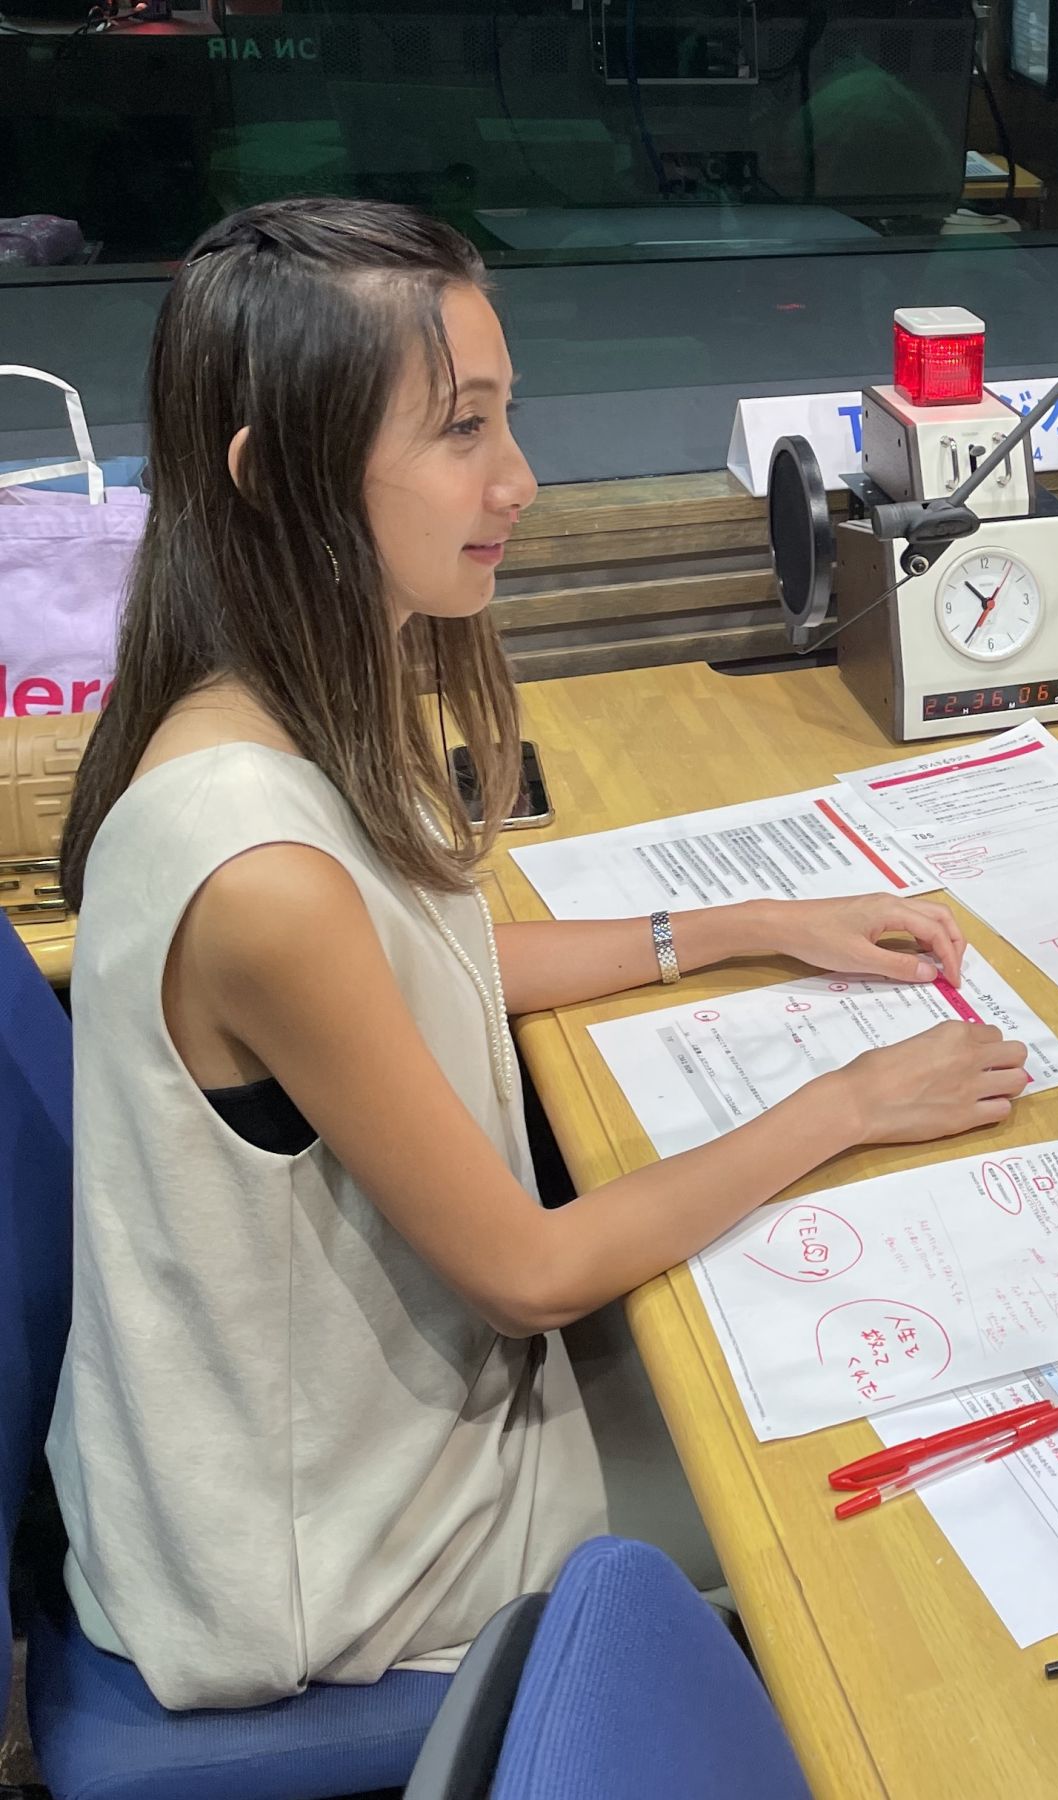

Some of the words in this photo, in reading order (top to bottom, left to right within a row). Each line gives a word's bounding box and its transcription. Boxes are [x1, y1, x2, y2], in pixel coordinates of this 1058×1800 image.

[980, 557, 989, 569] 12
[1023, 593, 1030, 605] 3
[945, 602, 952, 614] 9
[987, 638, 994, 650] 6
[925, 696, 957, 716] 22
[972, 691, 1003, 709] 36
[1018, 684, 1049, 704] 06
[883, 1311, 922, 1361] 人生を
[860, 1326, 891, 1367] 救って
